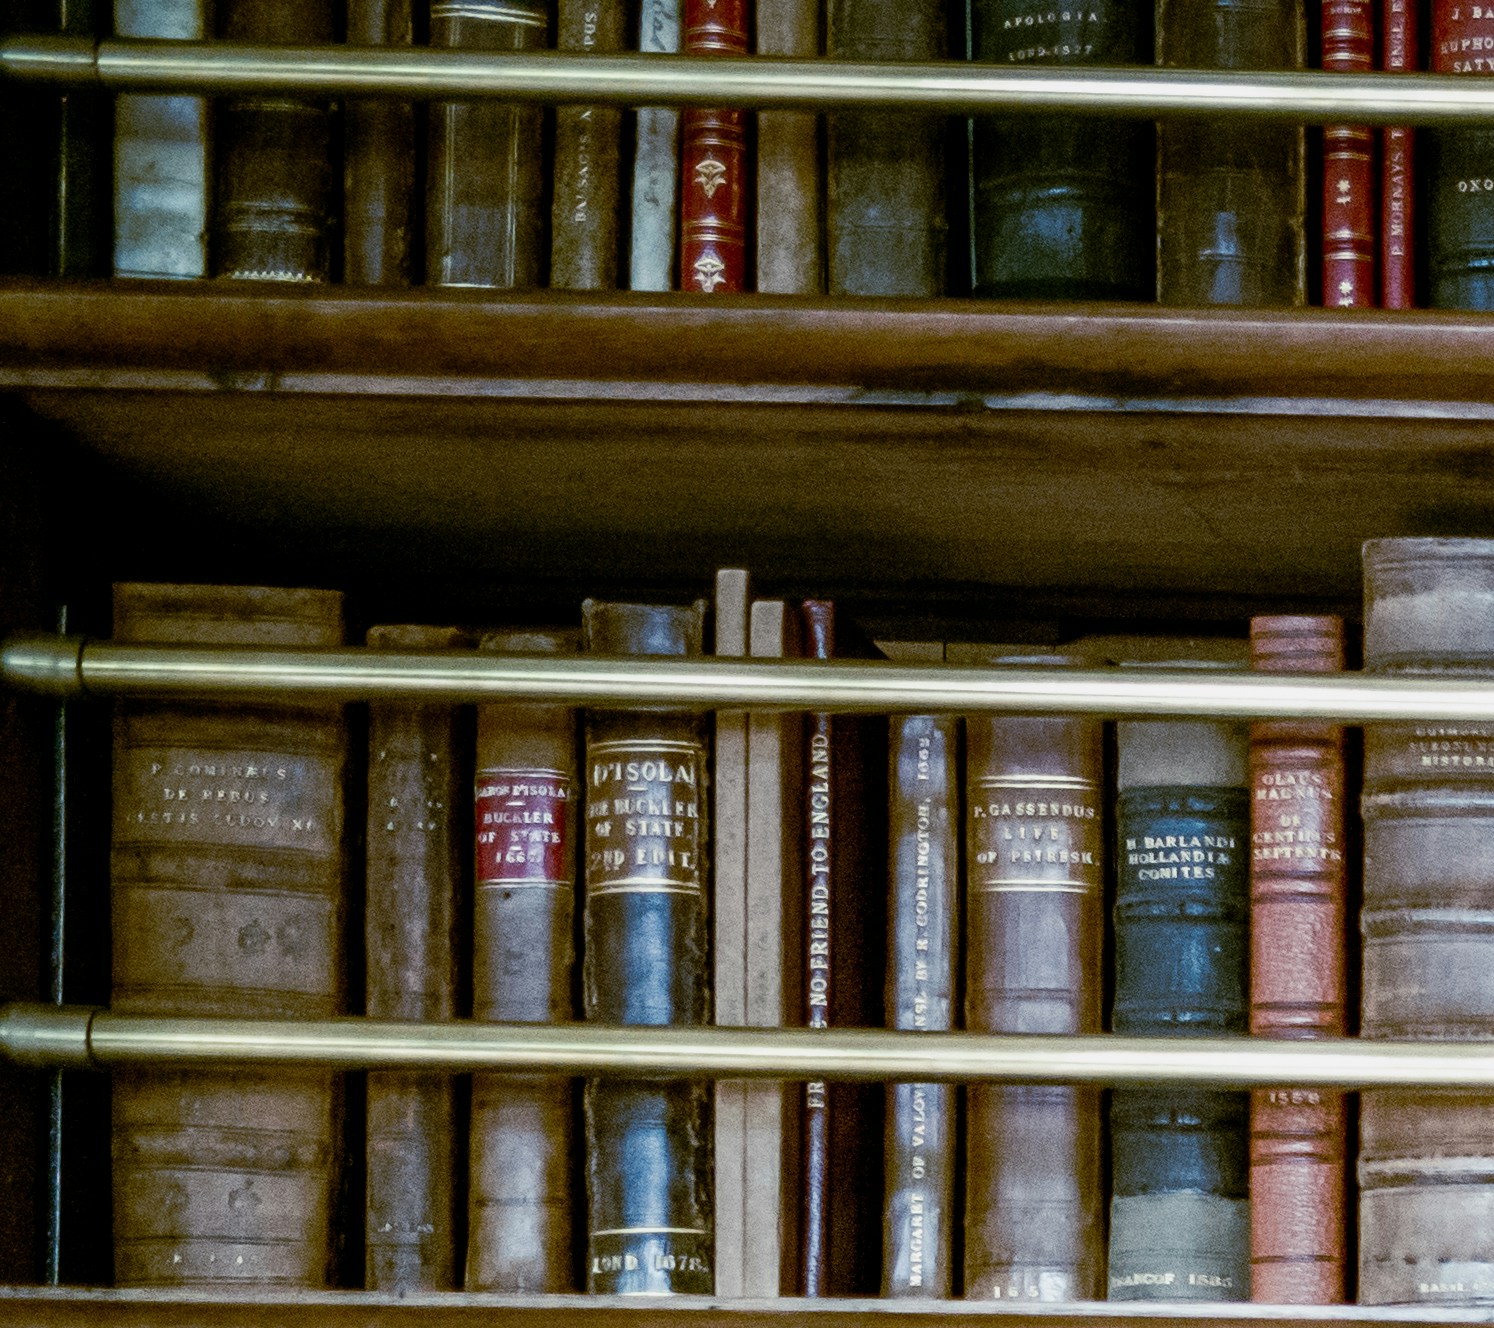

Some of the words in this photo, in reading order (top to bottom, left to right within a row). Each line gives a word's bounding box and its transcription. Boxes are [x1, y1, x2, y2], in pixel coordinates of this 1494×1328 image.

[811, 733, 830, 838] ENGLAND
[811, 848, 828, 875] TO
[810, 885, 830, 969] FRIEND
[810, 978, 827, 1006] NO
[912, 1156, 925, 1178] OF
[910, 1193, 924, 1286] MARGARET
